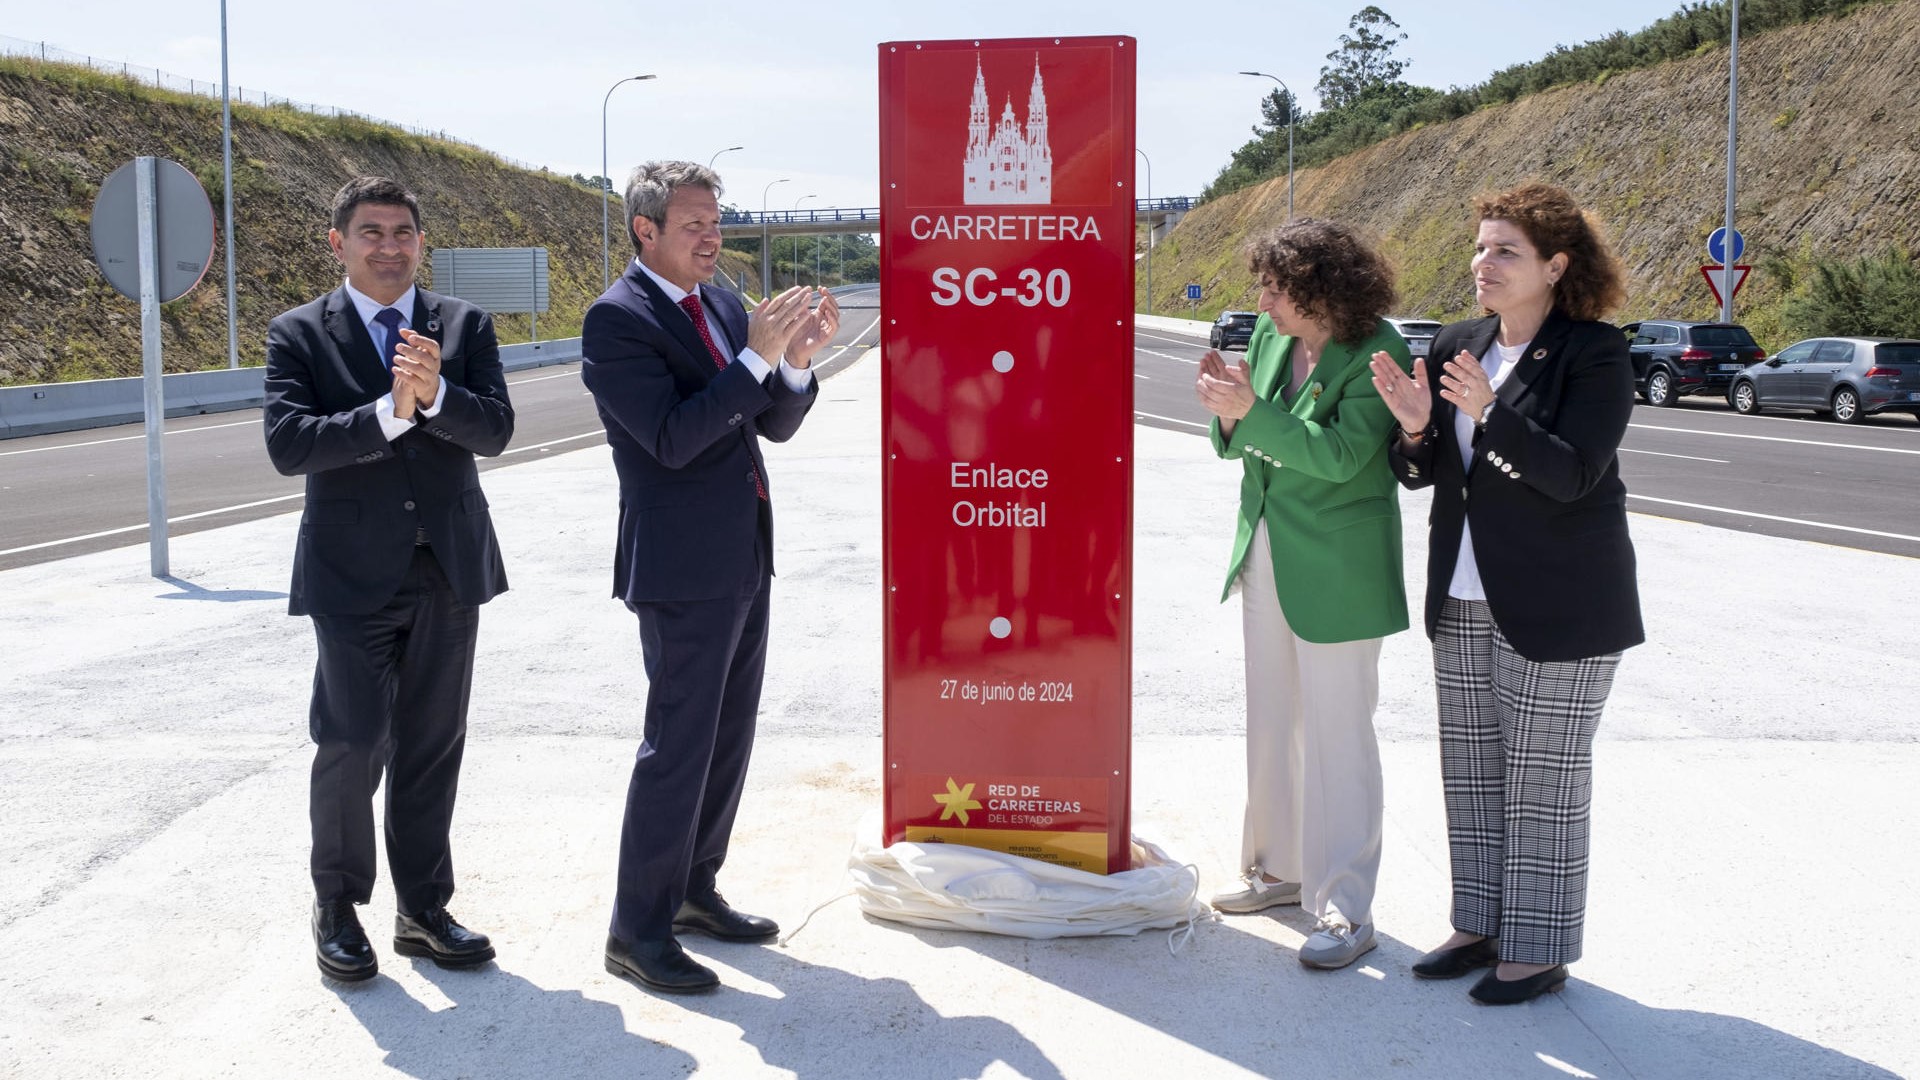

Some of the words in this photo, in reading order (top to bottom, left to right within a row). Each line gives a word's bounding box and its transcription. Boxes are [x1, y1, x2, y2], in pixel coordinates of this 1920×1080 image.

[910, 215, 1102, 241] CARRETERA
[930, 266, 1072, 308] SC-30
[951, 462, 1049, 489] Enlace
[952, 500, 1046, 528] Orbital
[940, 679, 958, 699] 27
[961, 680, 979, 701] de
[980, 681, 1015, 705] junio
[1018, 681, 1036, 702] de
[1039, 682, 1073, 702] 2024
[988, 784, 1017, 797] RED
[1021, 785, 1040, 797] DE
[988, 799, 1081, 813] CARRETERAS
[988, 814, 1008, 823] DEL
[1011, 814, 1053, 825] ESTADO
